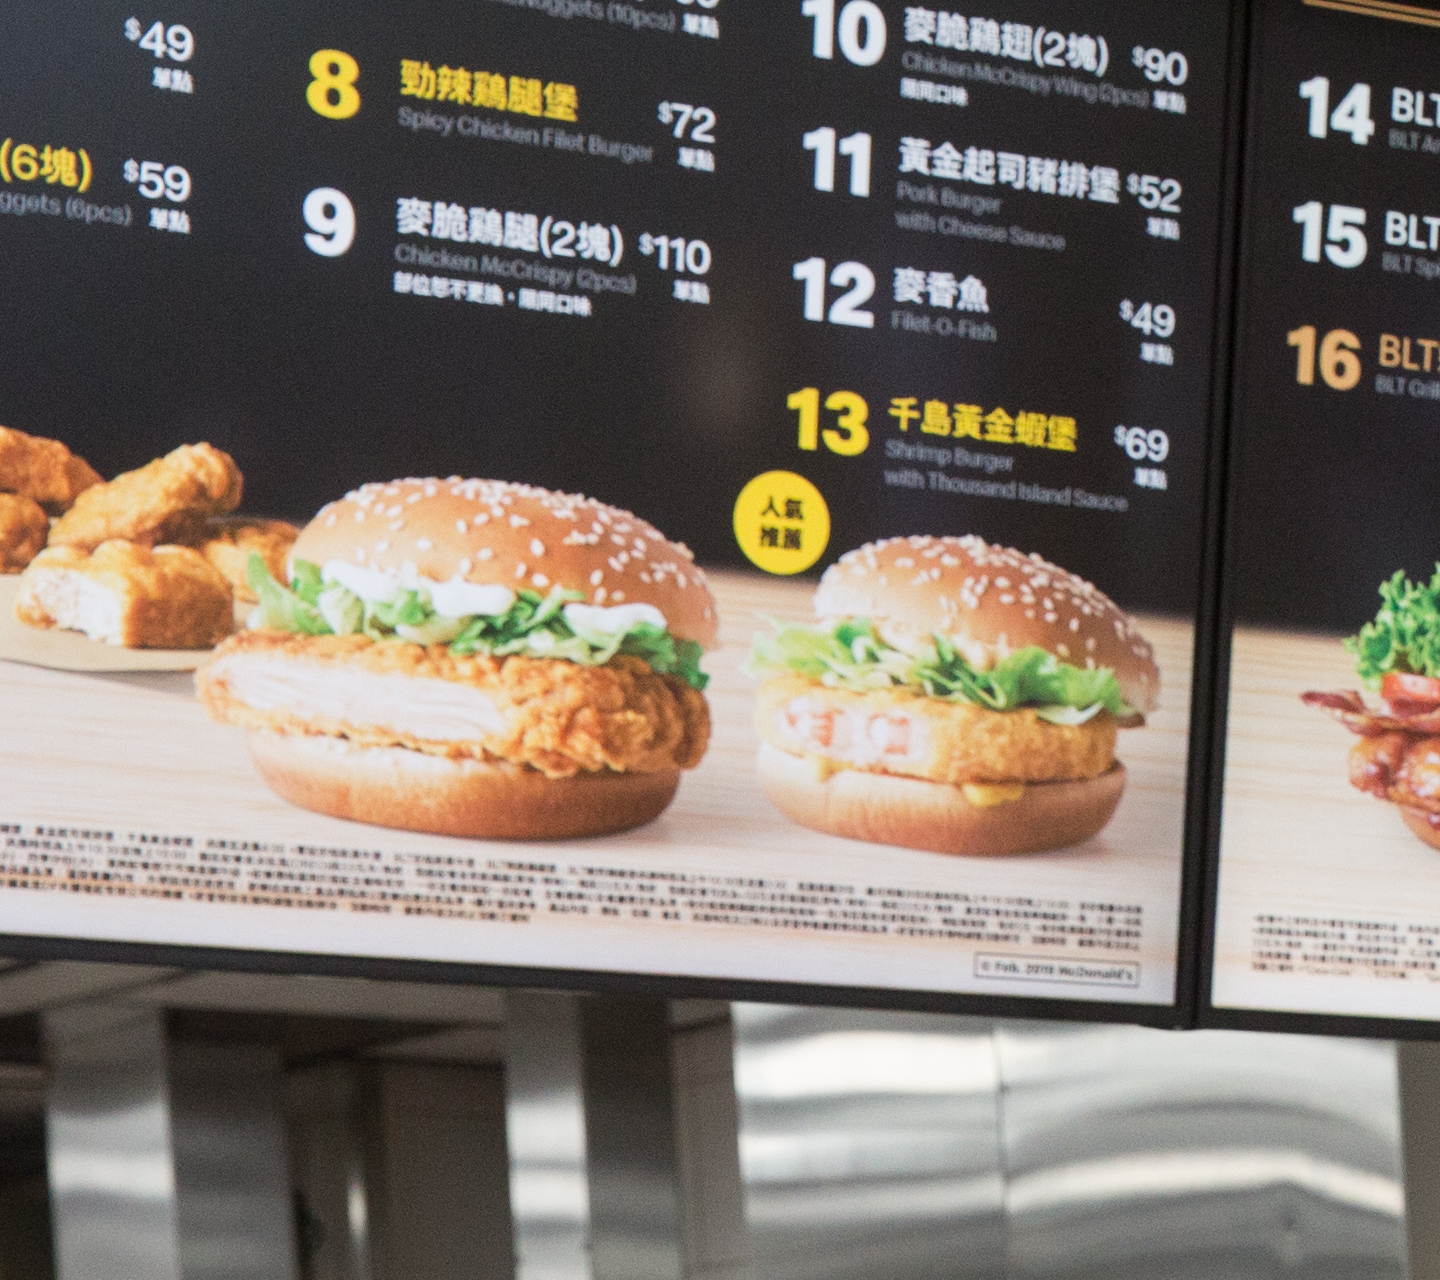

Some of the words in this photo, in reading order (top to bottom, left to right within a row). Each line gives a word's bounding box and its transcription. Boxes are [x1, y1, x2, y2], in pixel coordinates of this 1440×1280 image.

[125, 17, 195, 62] $49
[800, 0, 886, 66] 10
[306, 49, 361, 119] 8
[1132, 45, 1189, 86] $90
[657, 100, 716, 144] $72
[1299, 75, 1375, 145] 14
[457, 115, 540, 145] Chicken
[588, 134, 653, 164] Burger
[802, 127, 871, 197] 11
[124, 158, 191, 202] $59
[1126, 172, 1182, 213] $52
[302, 187, 356, 257] 9
[1293, 200, 1368, 268] 15
[638, 233, 711, 275] $110
[792, 257, 874, 328] 12
[893, 267, 989, 313] 麥香魚
[1119, 299, 1176, 337] $49
[1287, 325, 1362, 390] 16
[786, 387, 869, 456] 13
[1114, 425, 1169, 462] $69
